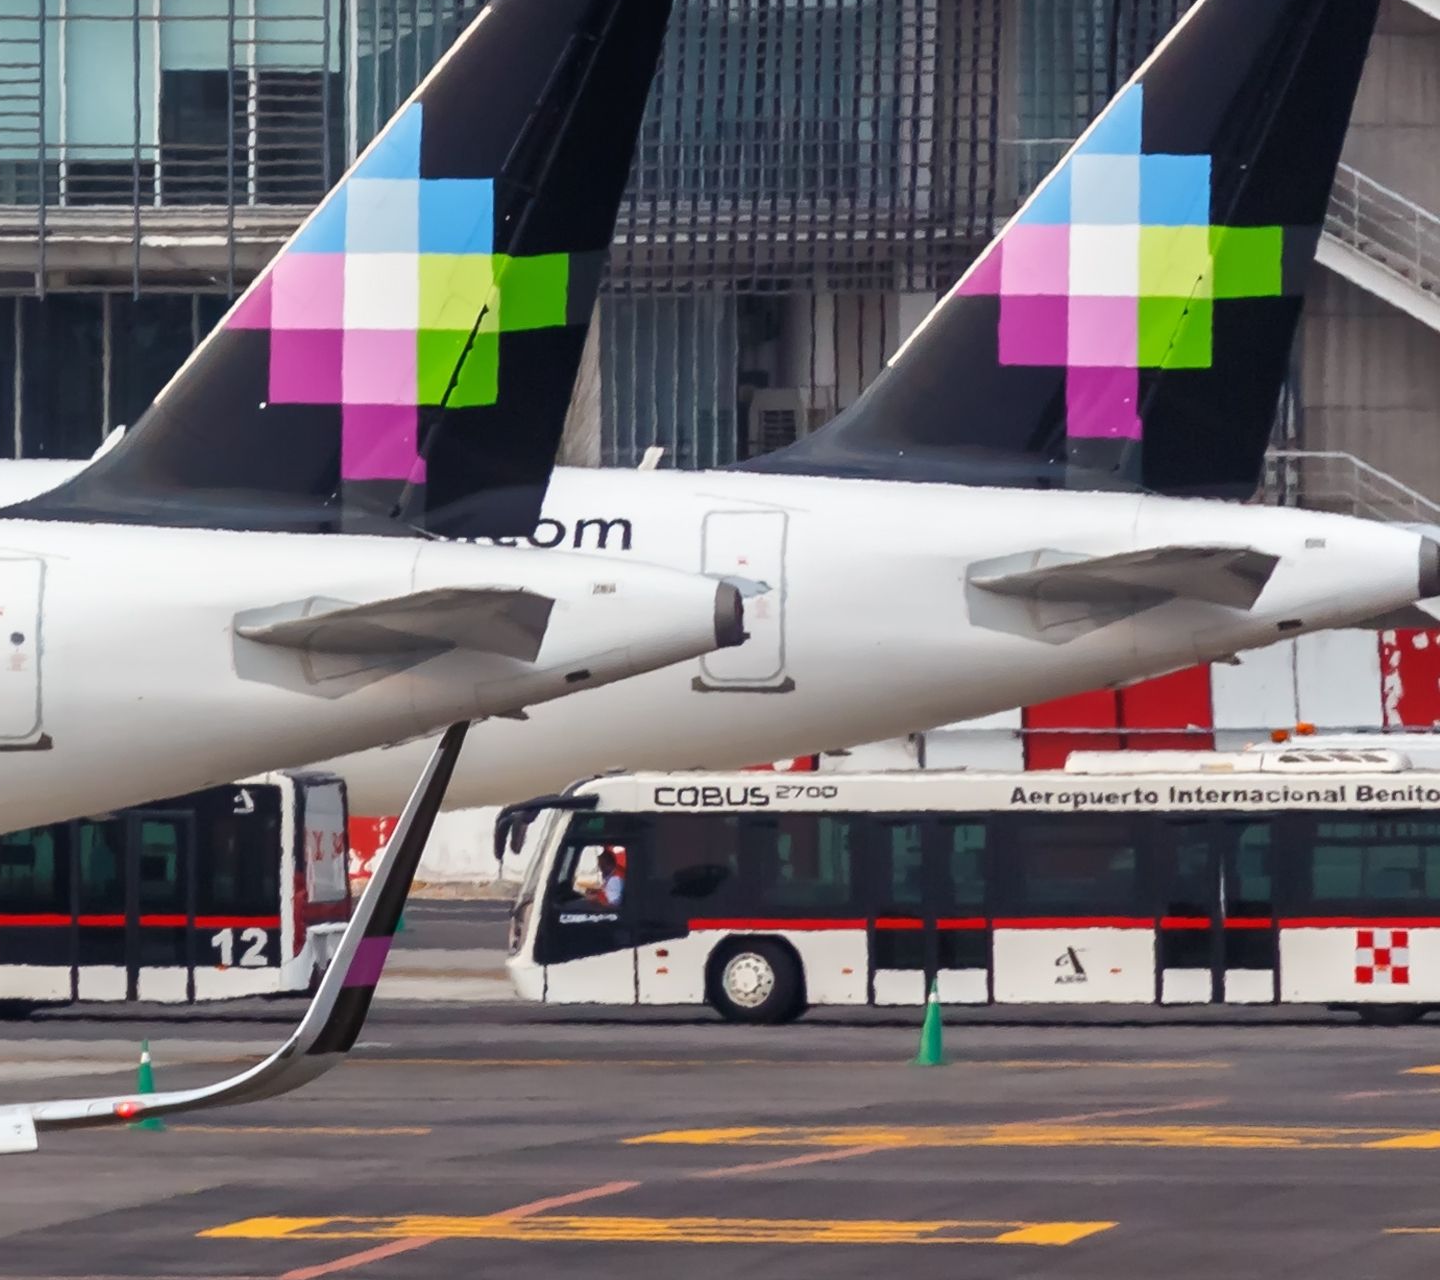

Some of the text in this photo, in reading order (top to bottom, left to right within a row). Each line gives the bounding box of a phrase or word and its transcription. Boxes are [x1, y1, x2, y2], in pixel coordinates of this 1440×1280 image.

[654, 784, 839, 807] COBUS 2700
[1010, 784, 1440, 809] Aeropuerto Internacional Benito
[211, 927, 269, 967] 12
